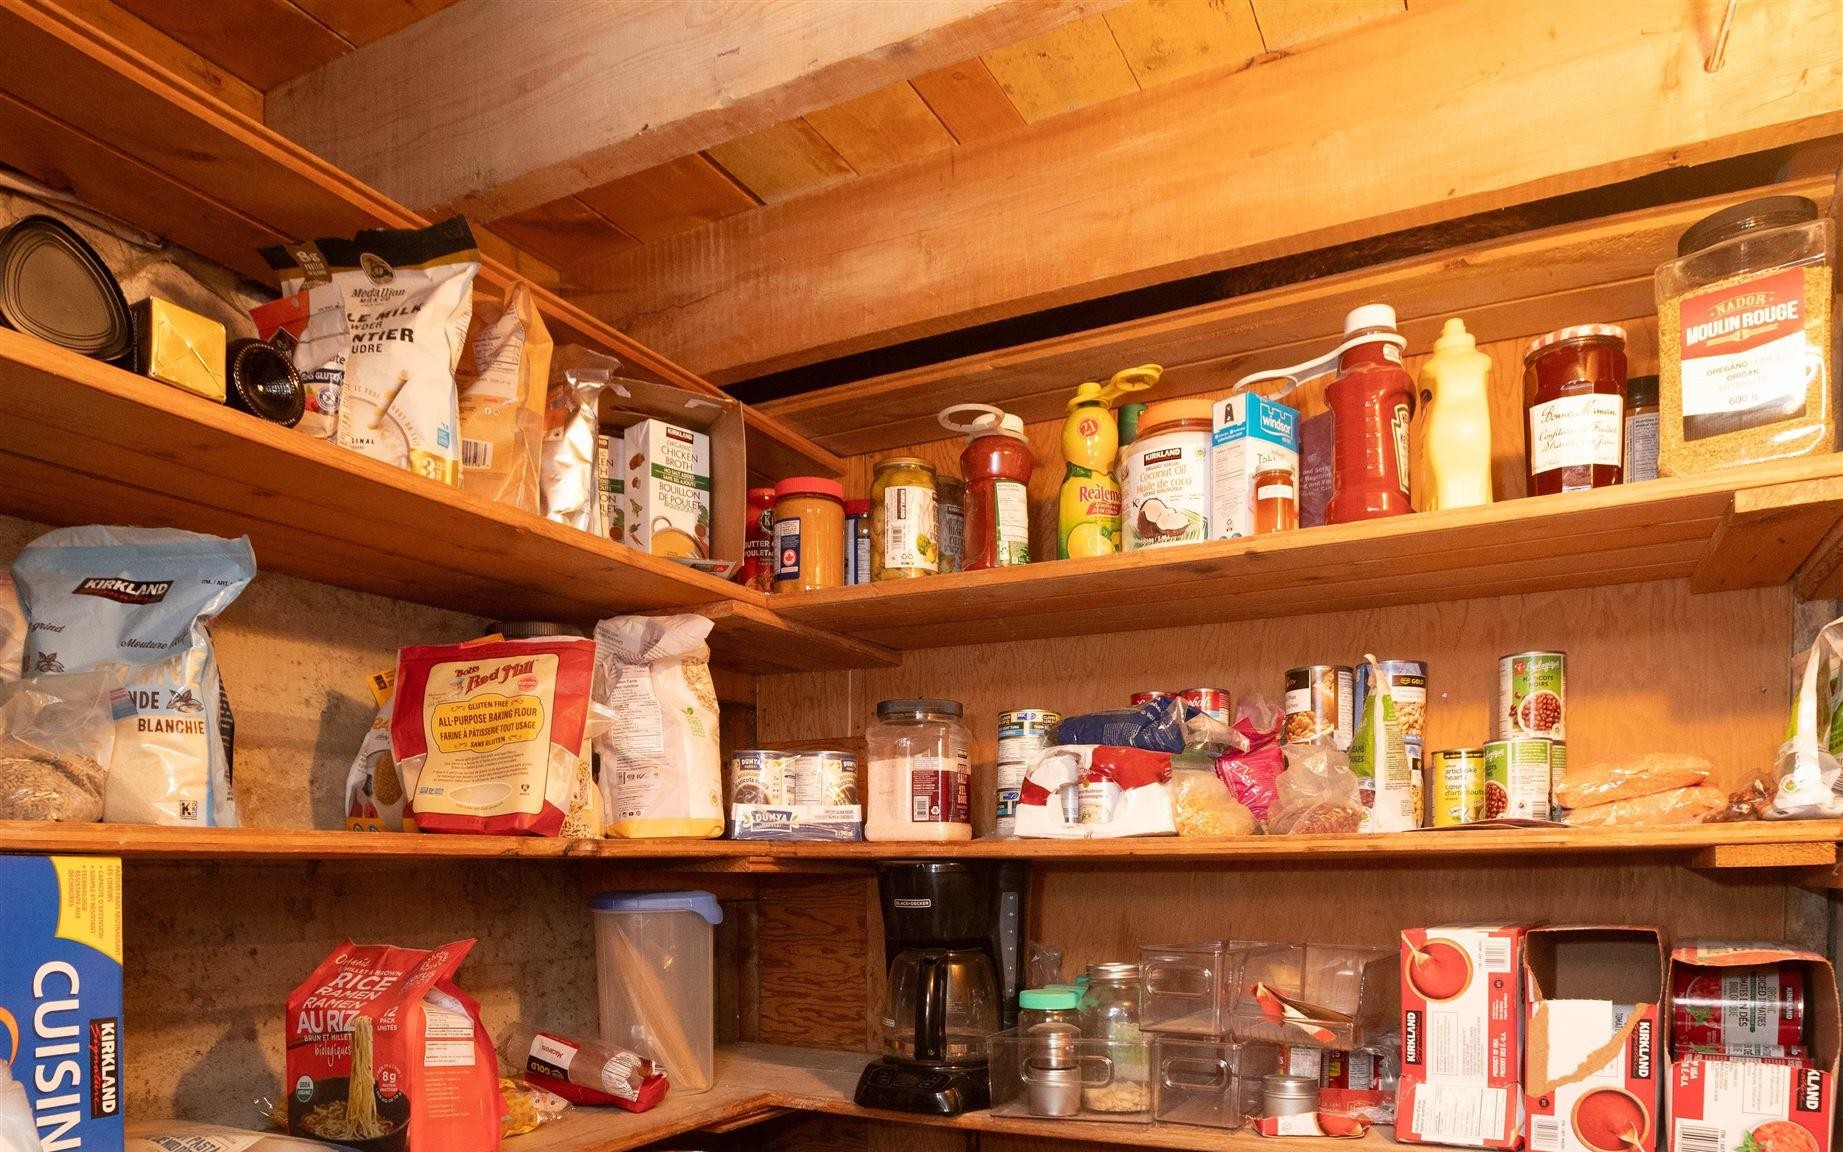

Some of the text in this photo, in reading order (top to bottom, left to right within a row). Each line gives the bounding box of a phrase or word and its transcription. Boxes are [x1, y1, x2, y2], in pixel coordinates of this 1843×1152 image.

[351, 288, 405, 299] Medallion
[377, 302, 425, 321] MILK
[1716, 293, 1767, 316] NADOR
[1686, 300, 1799, 346] MOULIN ROUGE
[1706, 361, 1748, 376] OREGANO
[1727, 369, 1759, 382] ORIGAN
[1080, 421, 1096, 434] 21
[1262, 415, 1291, 434] windsor
[661, 446, 698, 462] CHICKEN
[667, 441, 692, 452] ORGANIC
[1145, 449, 1180, 461] KIRKLAND
[666, 457, 693, 471] BROTH
[1140, 465, 1186, 481] Coconut Oil
[660, 482, 700, 500] BOUILLON
[1137, 482, 1154, 493] Huile
[1157, 480, 1168, 488] de
[659, 492, 701, 510] DE POULET
[83, 578, 169, 597] KIRKLAND
[31, 622, 66, 635] grind
[120, 638, 168, 651] Mouture
[465, 659, 534, 695] Red Mill
[468, 701, 492, 710] GLUTEN
[438, 708, 537, 727] ALL-PURPOSE BAKING FLOUR
[138, 719, 205, 735] BLANCHIE
[440, 730, 462, 740] FARINE
[468, 725, 499, 737] PÂTISSERIE
[500, 724, 514, 733] TOUT
[515, 721, 536, 730] USAGE
[470, 737, 506, 748] SANS GLUTEN
[755, 813, 787, 822] DUNYA
[336, 954, 371, 967] Organic
[329, 972, 398, 991] RICE
[1758, 976, 1767, 995] DICED
[315, 987, 382, 1001] RAMEN
[303, 997, 367, 1009] RAMEN
[1785, 987, 1794, 1020] KIRKLAND
[384, 1007, 399, 1018] 12
[1739, 1011, 1748, 1028] DÉS
[297, 1010, 361, 1034] AU RIZ
[377, 1023, 398, 1031] UNITÉS
[304, 1034, 322, 1042] BRUN
[1407, 1012, 1416, 1062] KIRKLAND
[315, 1044, 352, 1067] biologiques
[1638, 1021, 1650, 1078] KIRKLAND
[89, 1023, 103, 1116] Signature
[101, 1022, 117, 1114] KIRKLAND
[531, 1062, 551, 1076] GOLD
[382, 1071, 396, 1084] 8g
[1806, 1070, 1820, 1110] KLAND
